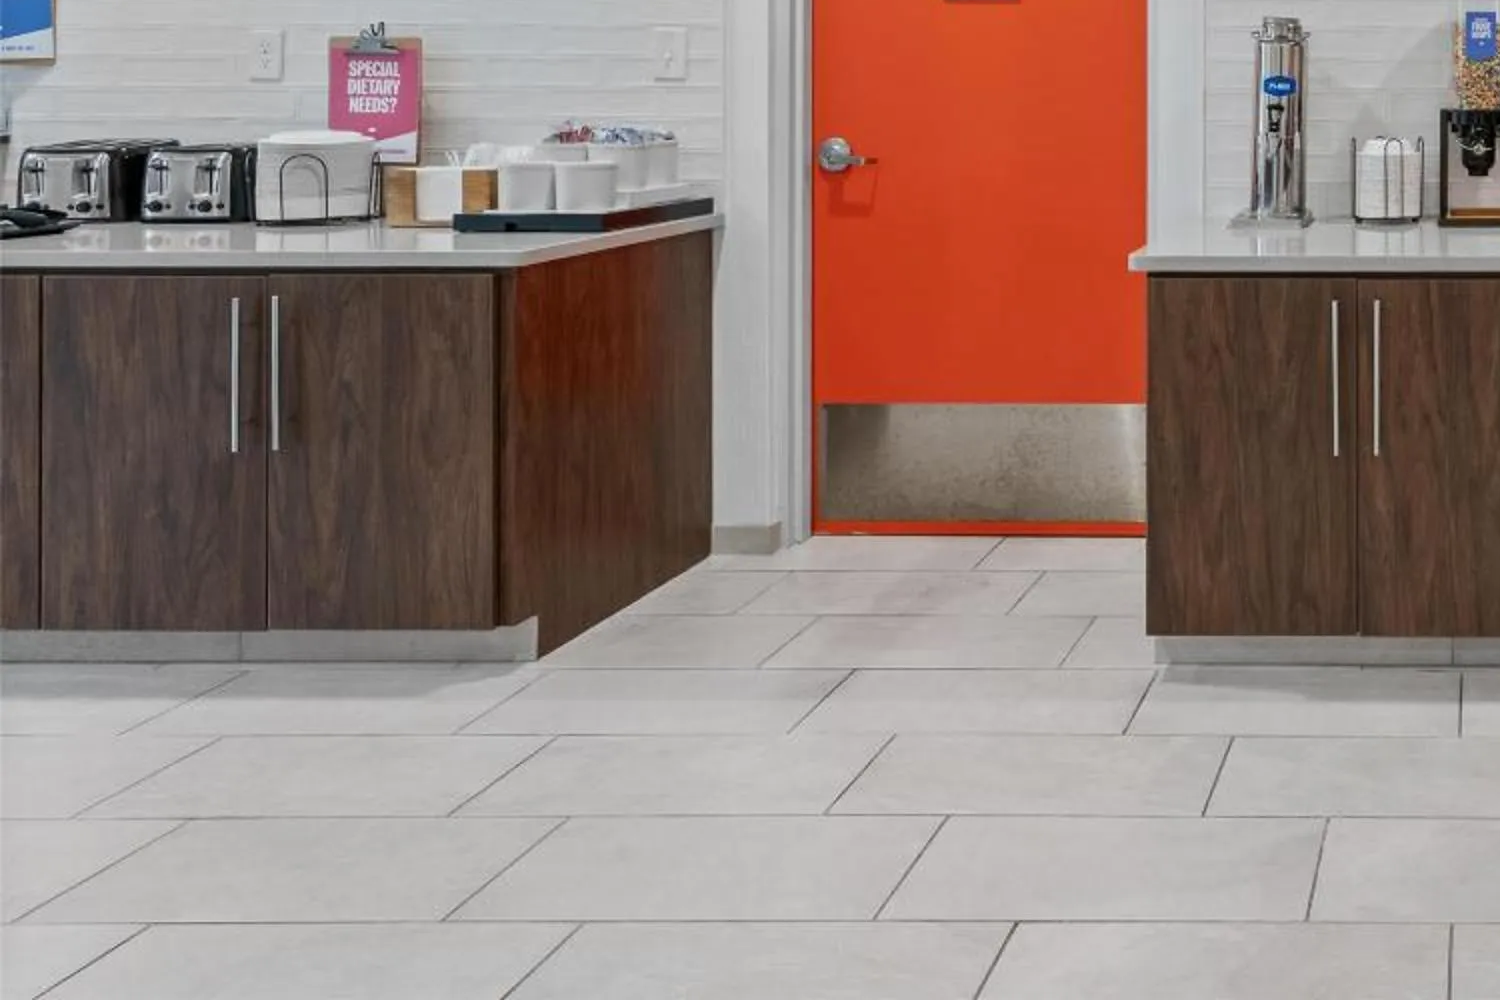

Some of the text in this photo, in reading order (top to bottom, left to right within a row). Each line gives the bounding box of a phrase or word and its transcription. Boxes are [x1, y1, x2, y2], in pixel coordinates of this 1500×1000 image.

[348, 60, 400, 77] SPECIAL
[348, 78, 400, 95] DIETARY
[348, 96, 397, 113] NEEDS?
